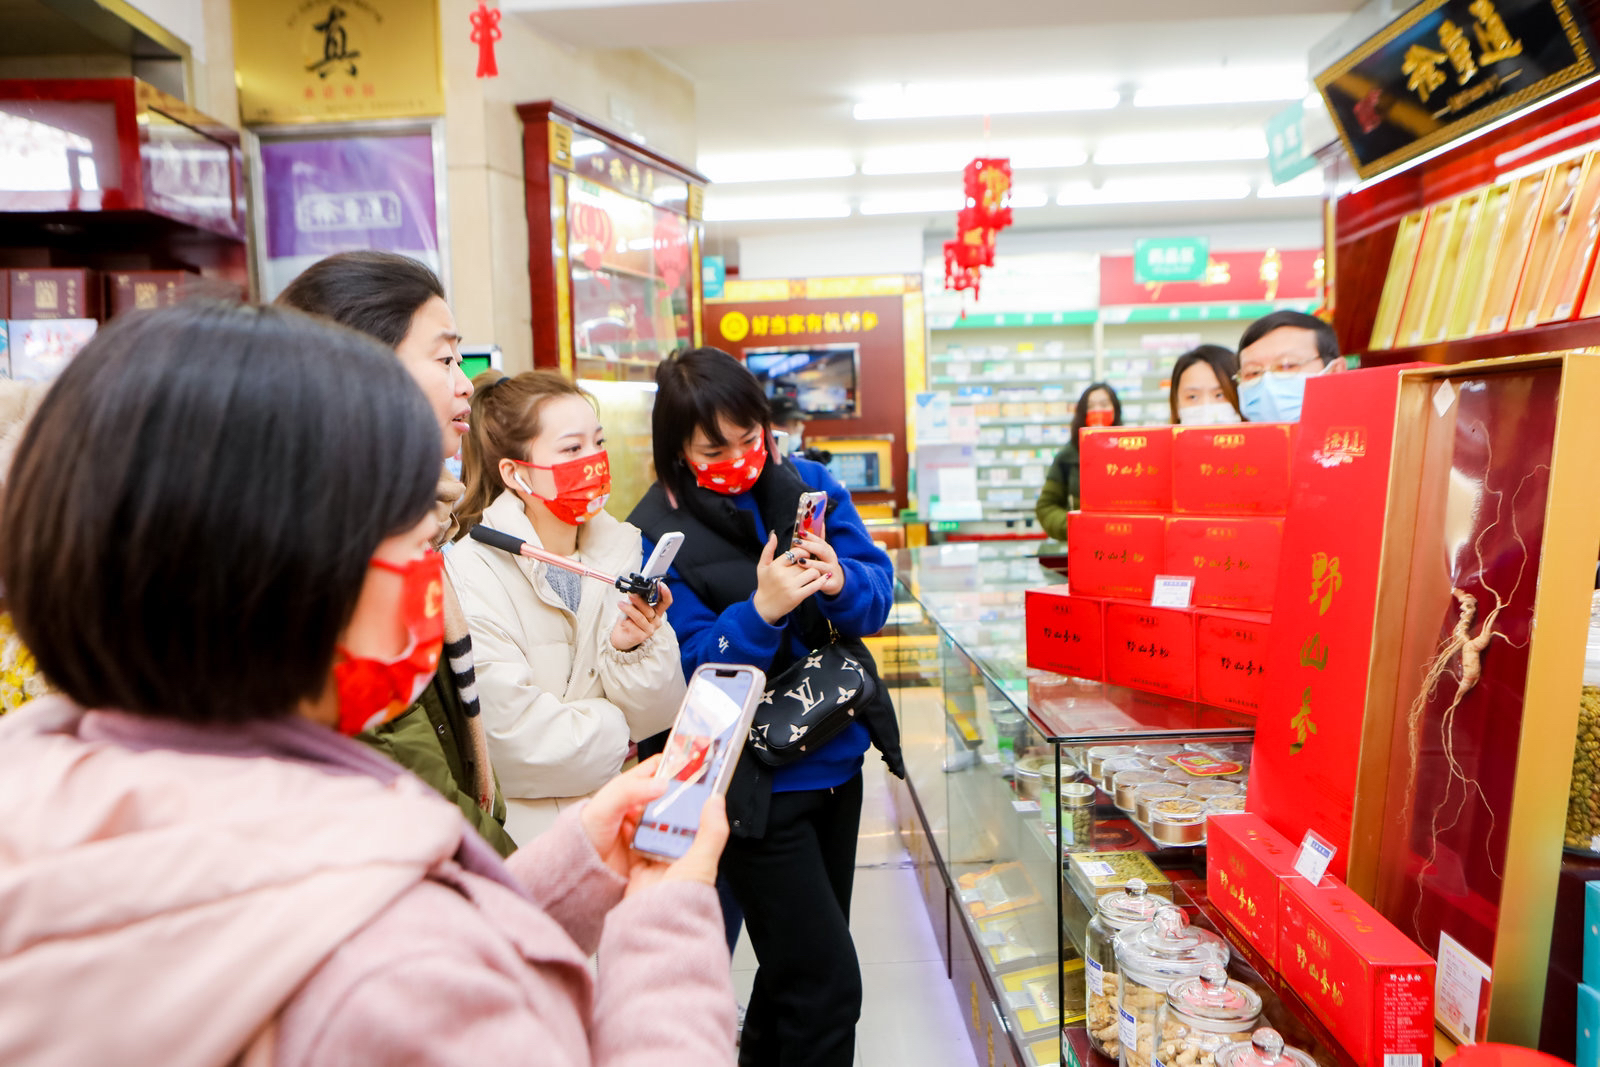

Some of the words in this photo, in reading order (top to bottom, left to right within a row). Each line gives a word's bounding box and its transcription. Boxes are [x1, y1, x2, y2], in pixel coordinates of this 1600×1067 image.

[305, 6, 361, 80] 真
[1289, 552, 1343, 756] 野山参
